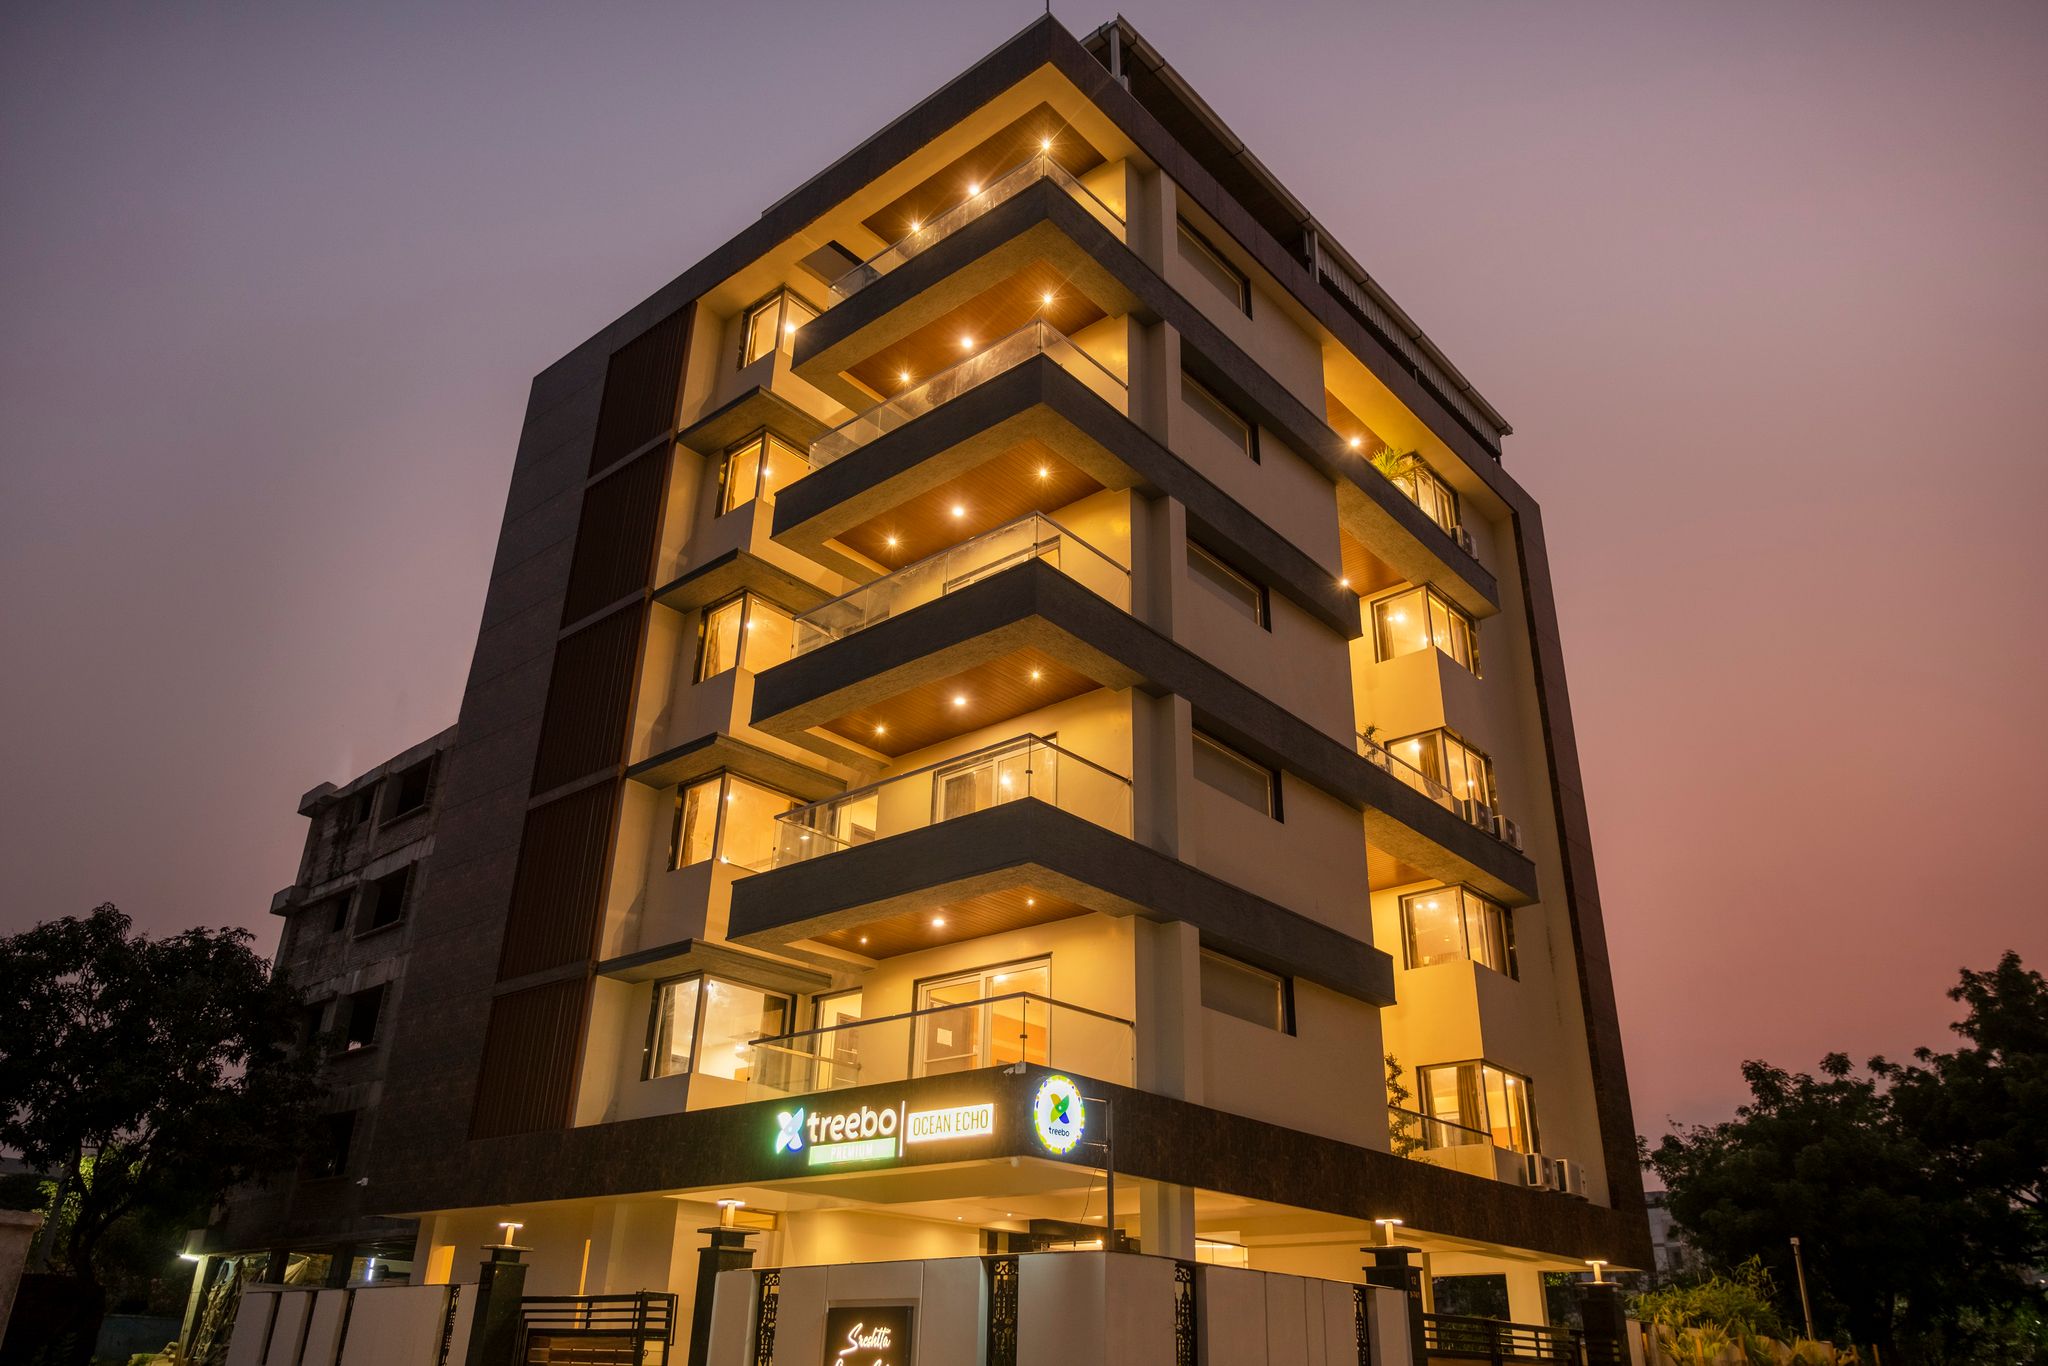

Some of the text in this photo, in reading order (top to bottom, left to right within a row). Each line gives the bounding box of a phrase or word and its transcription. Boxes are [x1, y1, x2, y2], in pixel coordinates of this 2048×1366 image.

[807, 1106, 897, 1142] treebo
[913, 1109, 989, 1136] OCEAN ECHO
[1048, 1126, 1070, 1137] treebo
[831, 1143, 873, 1161] PREMIUM
